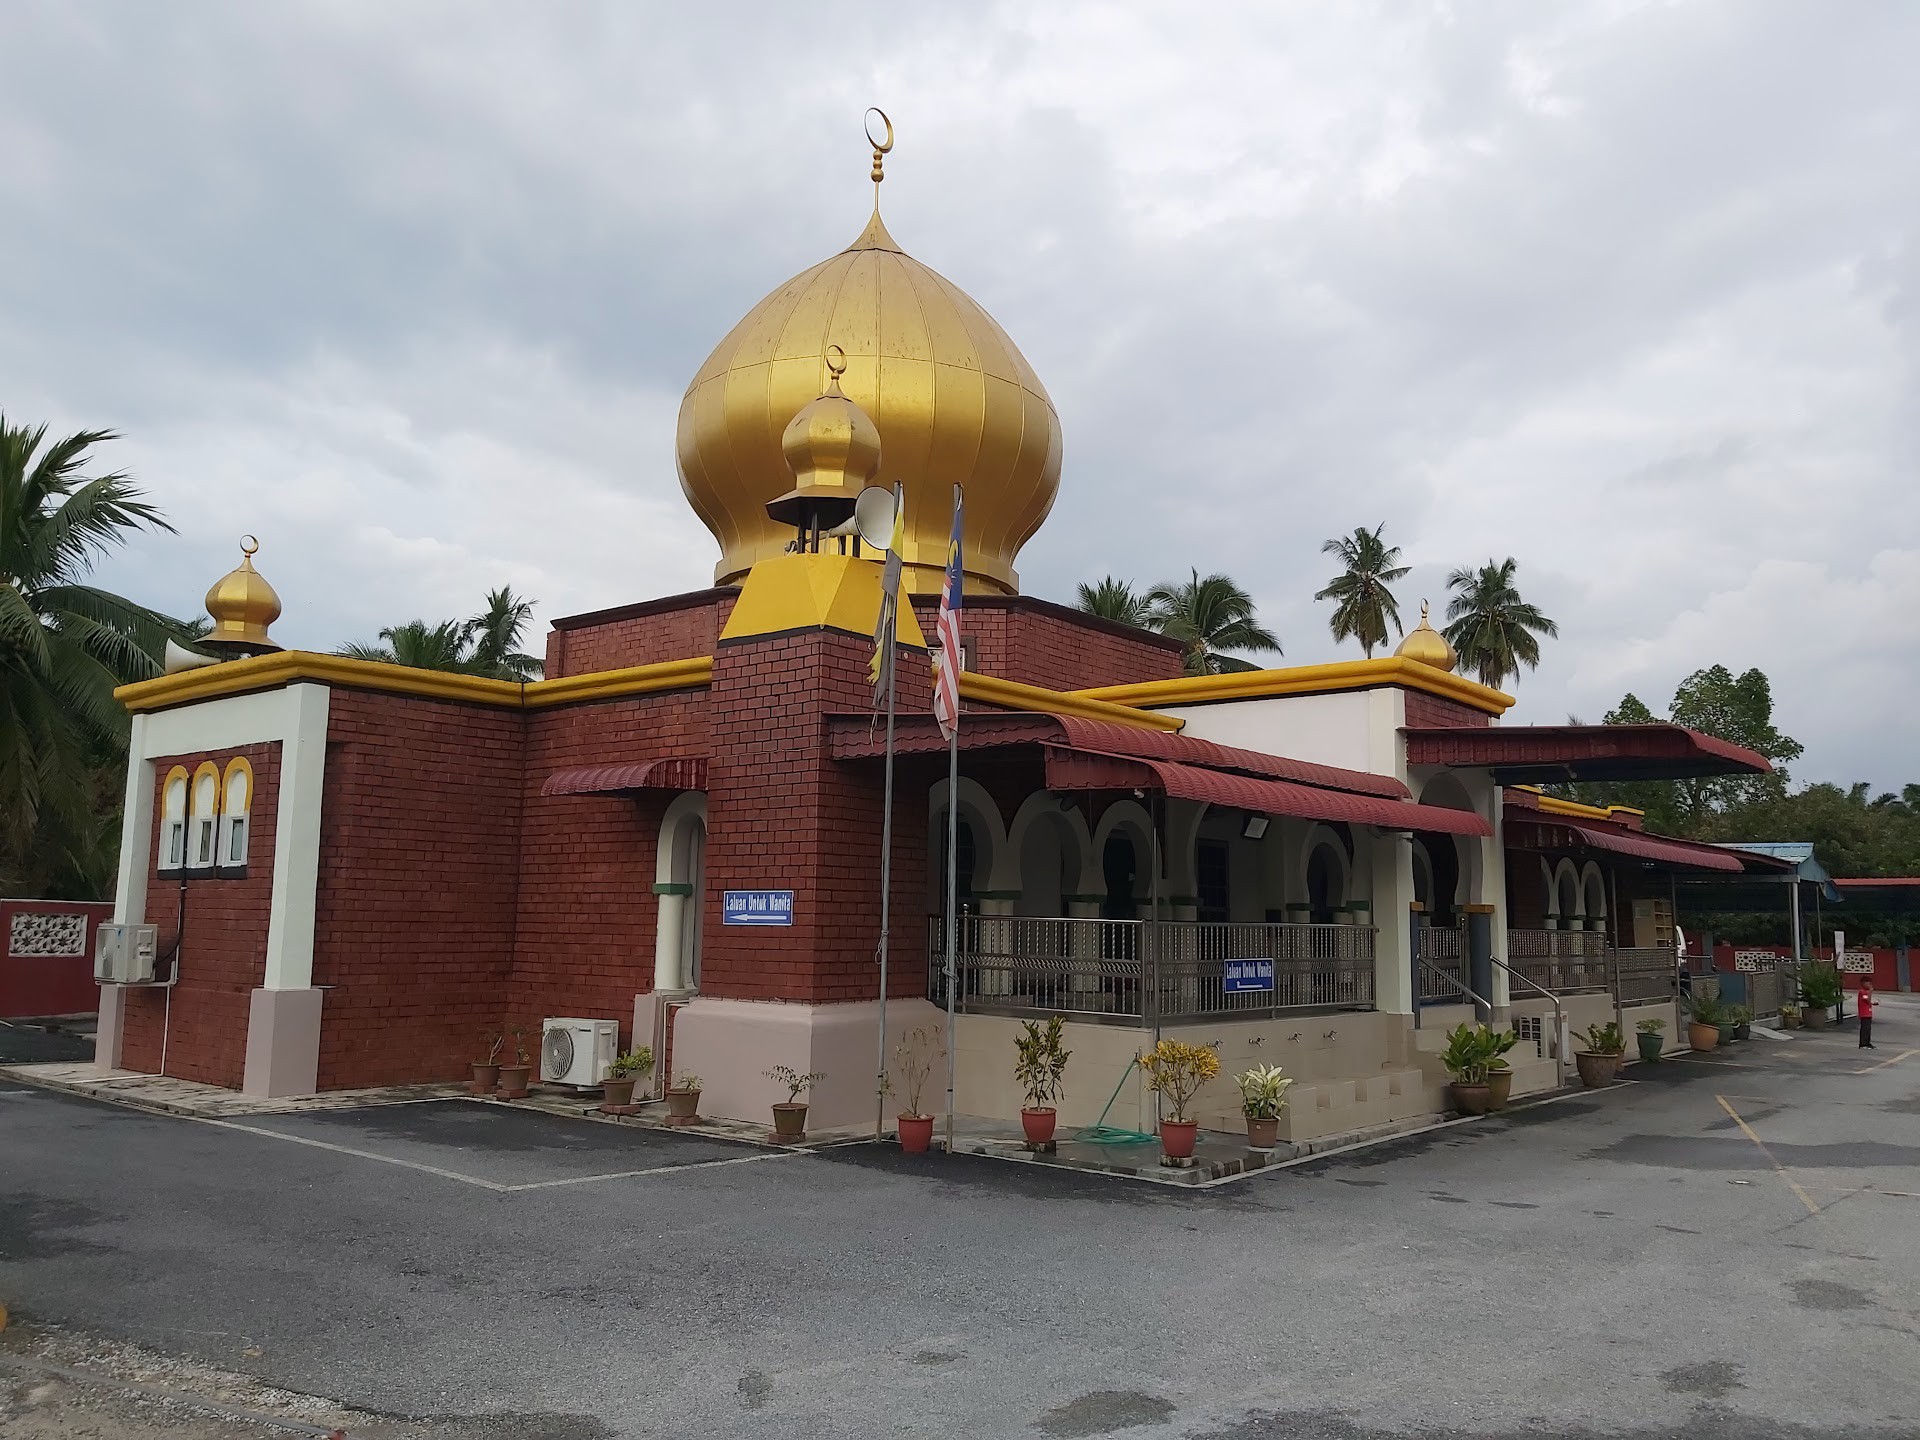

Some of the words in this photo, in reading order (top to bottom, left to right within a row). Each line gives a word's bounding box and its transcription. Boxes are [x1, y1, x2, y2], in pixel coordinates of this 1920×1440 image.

[726, 894, 746, 911] Laluan
[748, 894, 767, 911] Untuk
[769, 894, 791, 911] Wanita
